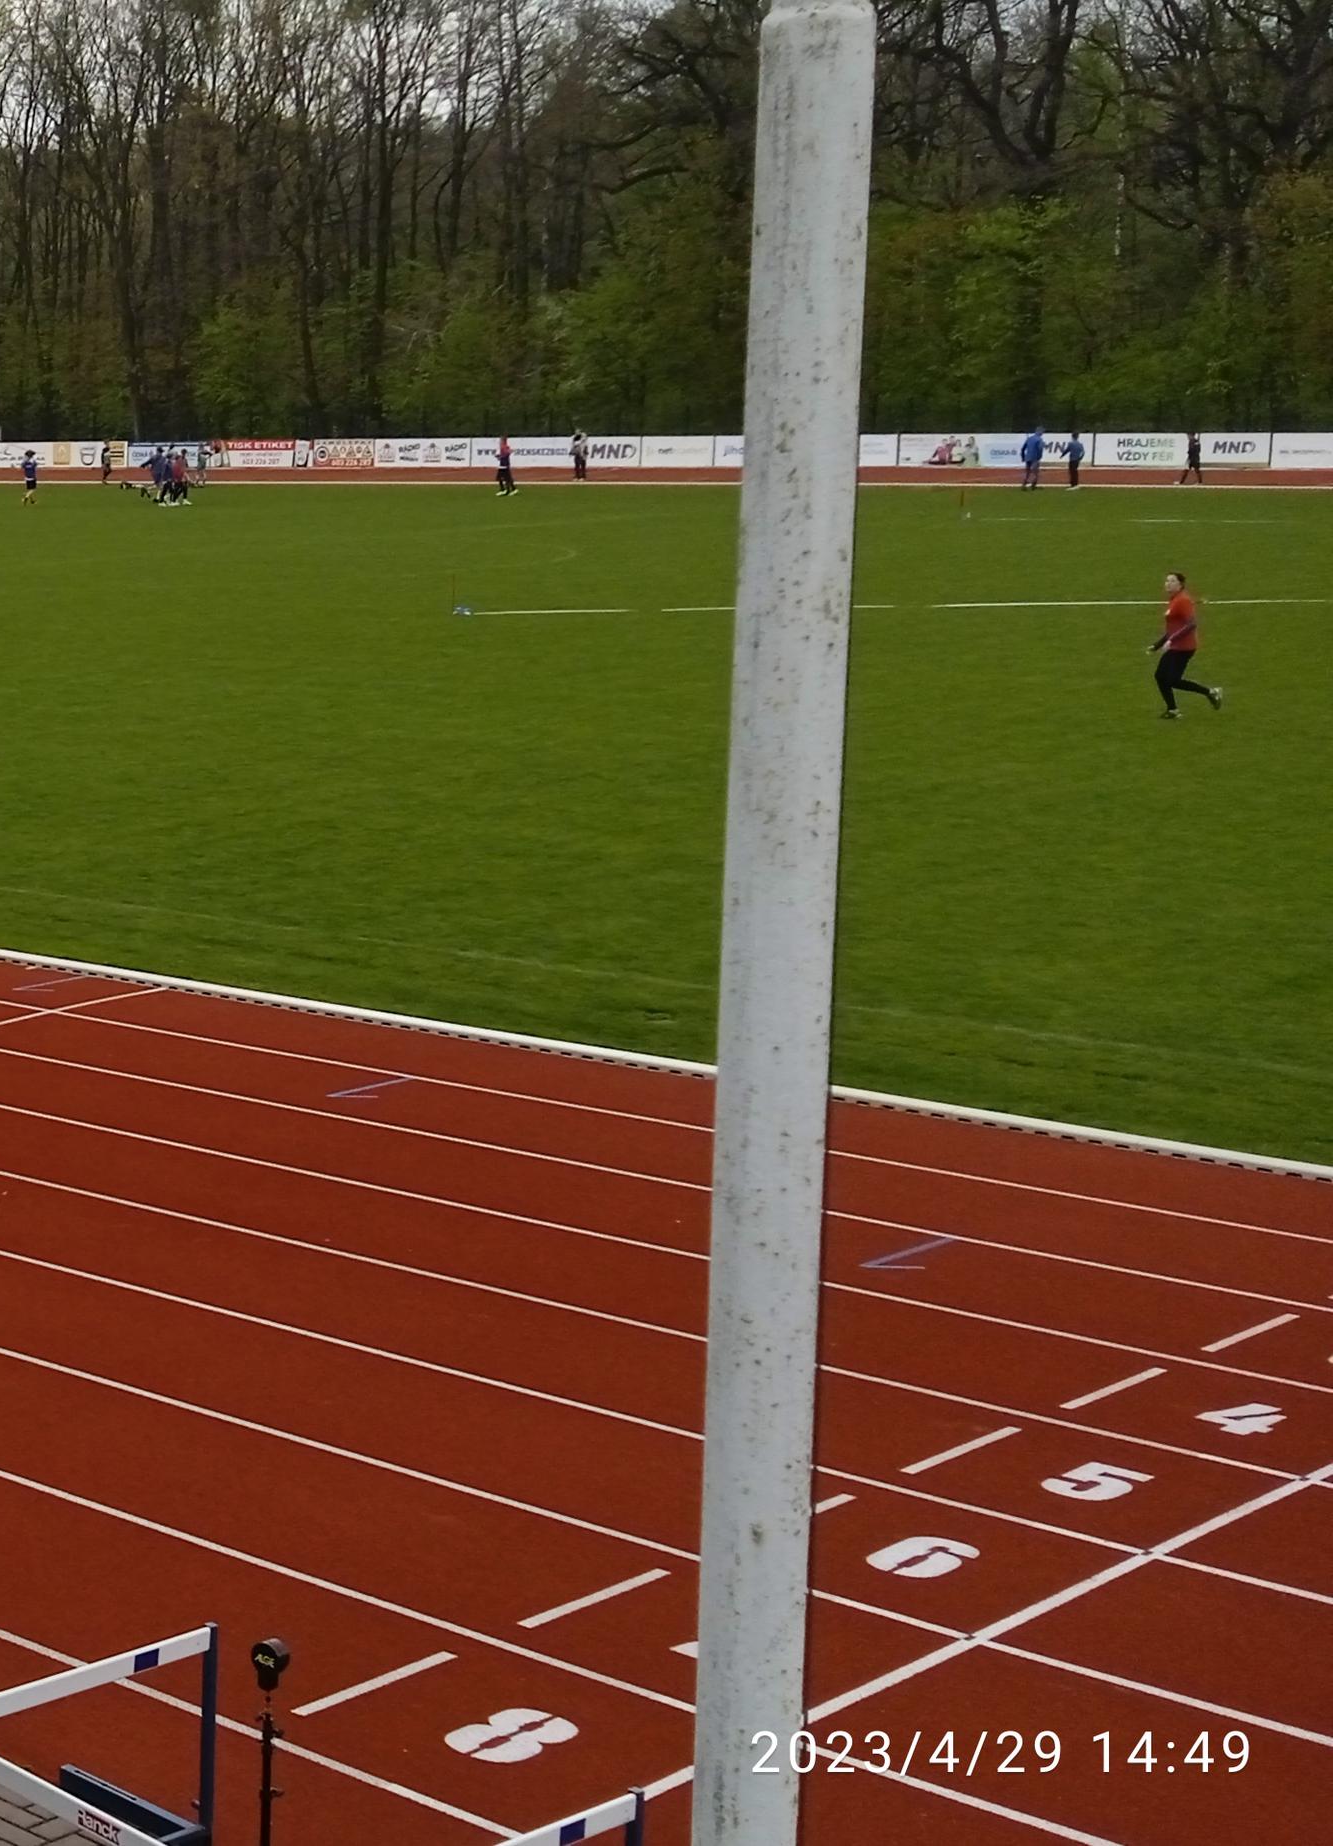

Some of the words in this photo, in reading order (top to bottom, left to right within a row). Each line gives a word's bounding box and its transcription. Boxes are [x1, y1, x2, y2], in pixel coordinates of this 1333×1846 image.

[228, 441, 252, 449] TISK
[254, 441, 293, 449] ETIKET
[590, 443, 637, 460] MND
[1117, 438, 1176, 448] HRAJEME
[1213, 440, 1256, 454] MND
[1117, 450, 1149, 461] VŽDY
[1195, 1403, 1288, 1436] 4
[1040, 1461, 1155, 1502] 5
[865, 1536, 981, 1578] 6
[443, 1707, 580, 1764] 8
